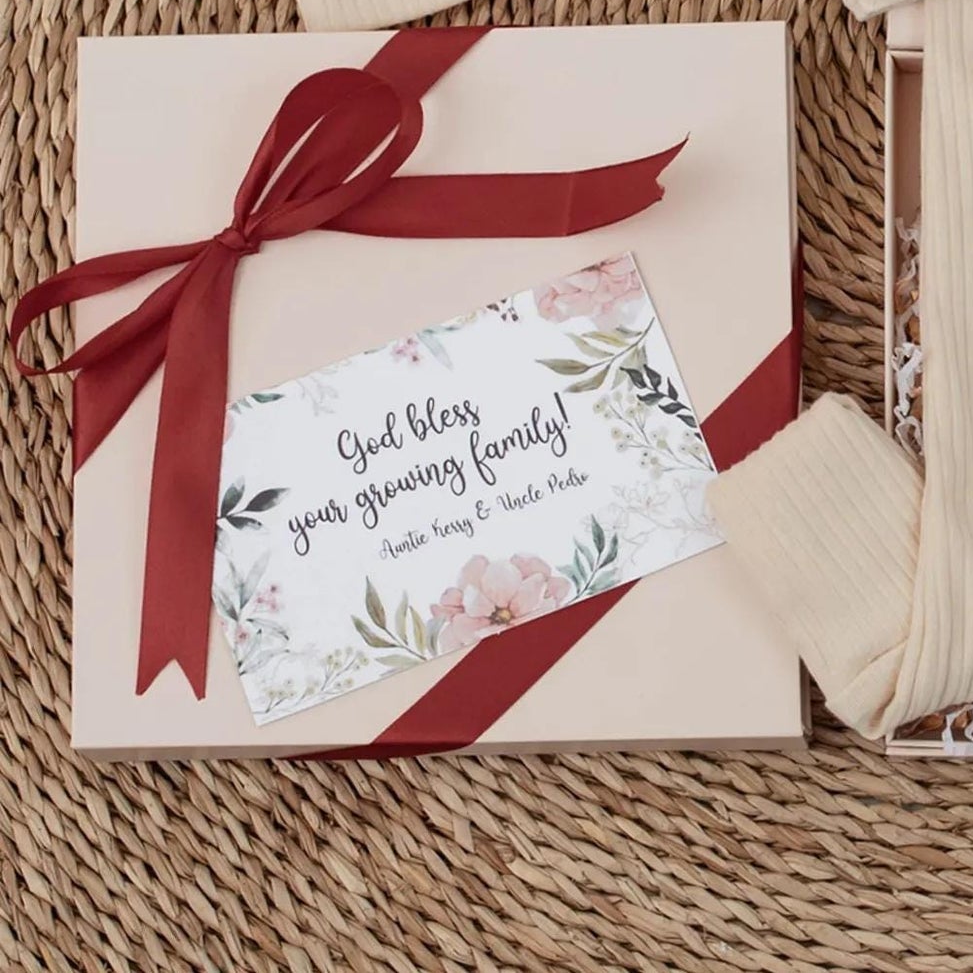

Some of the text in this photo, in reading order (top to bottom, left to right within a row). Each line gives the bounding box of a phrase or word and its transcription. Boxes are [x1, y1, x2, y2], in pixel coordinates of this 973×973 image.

[288, 391, 571, 556] your growing family!
[337, 396, 480, 474] God bless
[379, 467, 590, 560] Auntie Kerry & Uncle Pedro
